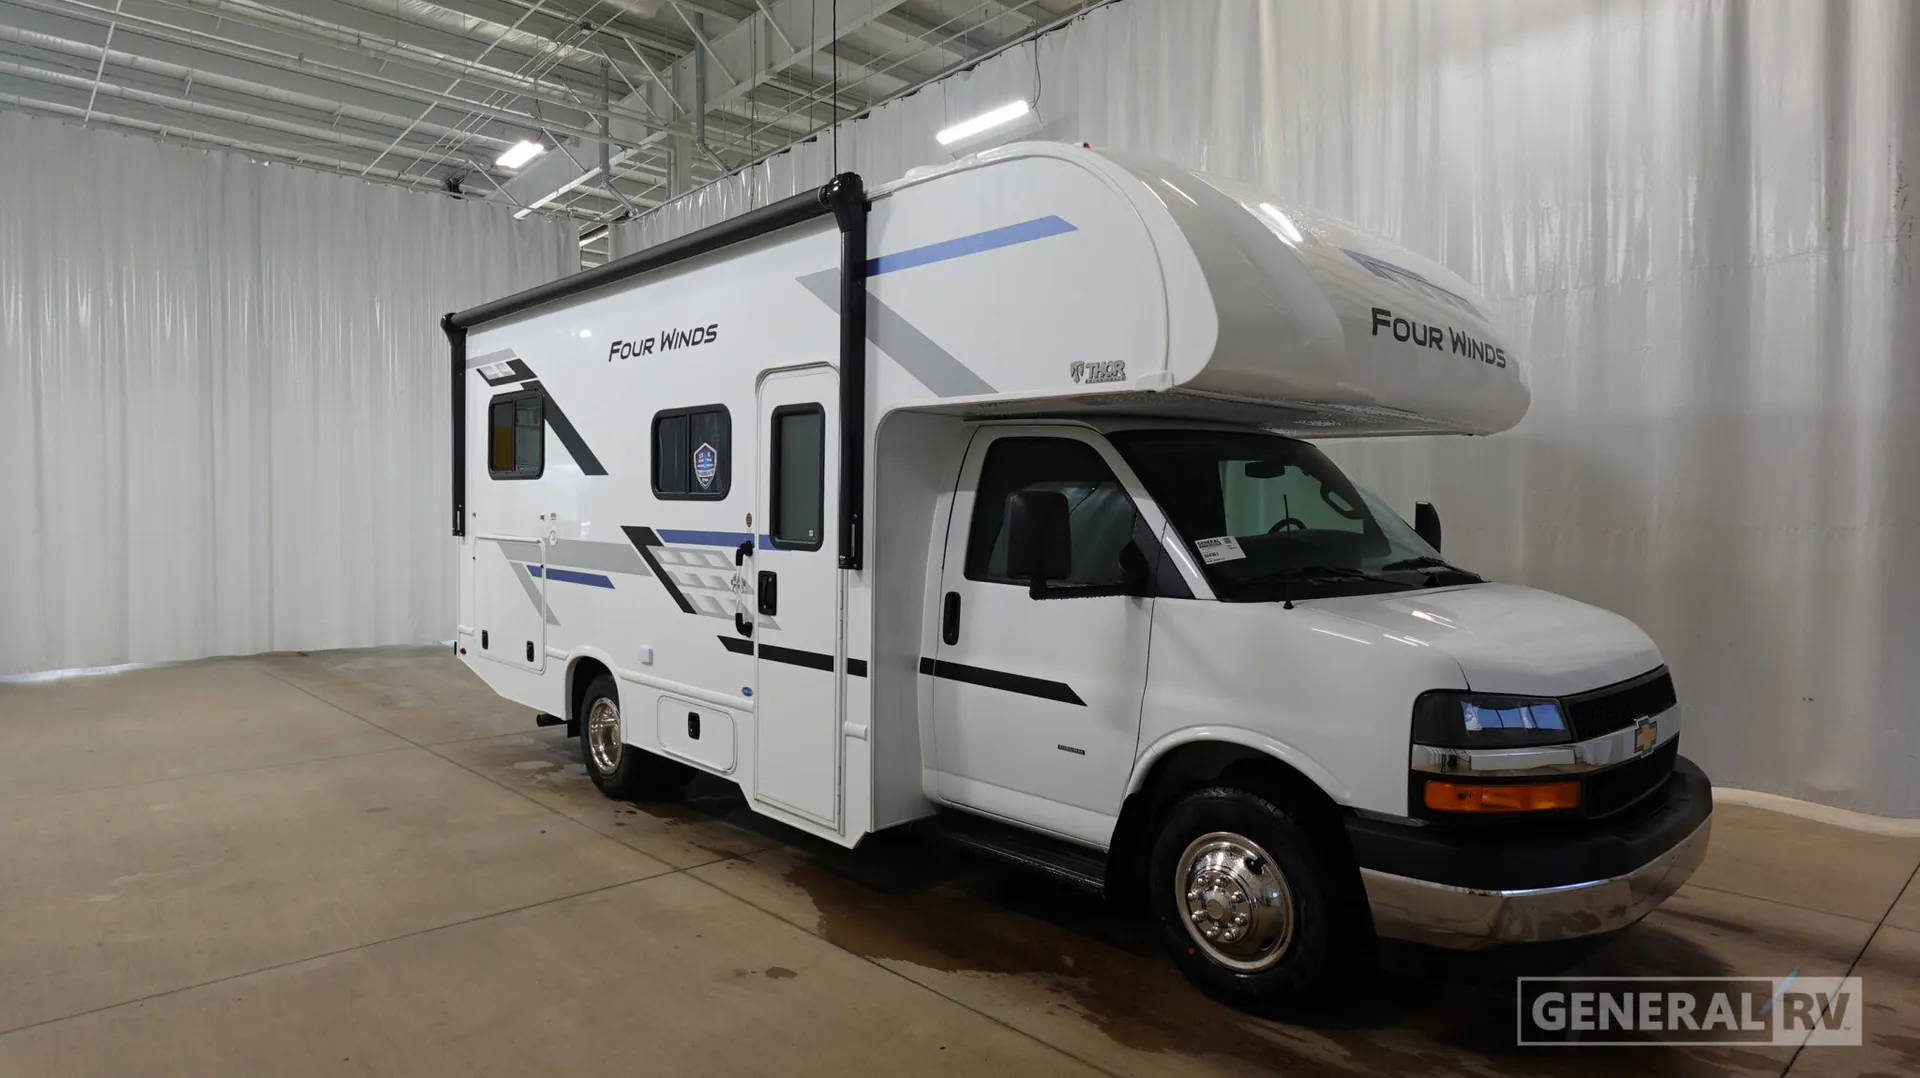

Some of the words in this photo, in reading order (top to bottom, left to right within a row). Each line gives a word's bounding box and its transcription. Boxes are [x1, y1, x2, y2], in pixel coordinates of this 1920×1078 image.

[608, 337, 655, 362] FOUR
[660, 323, 718, 352] WINDS
[1371, 307, 1444, 351] FOUR
[1448, 326, 1506, 368] WINDS
[1085, 360, 1126, 379] THOR
